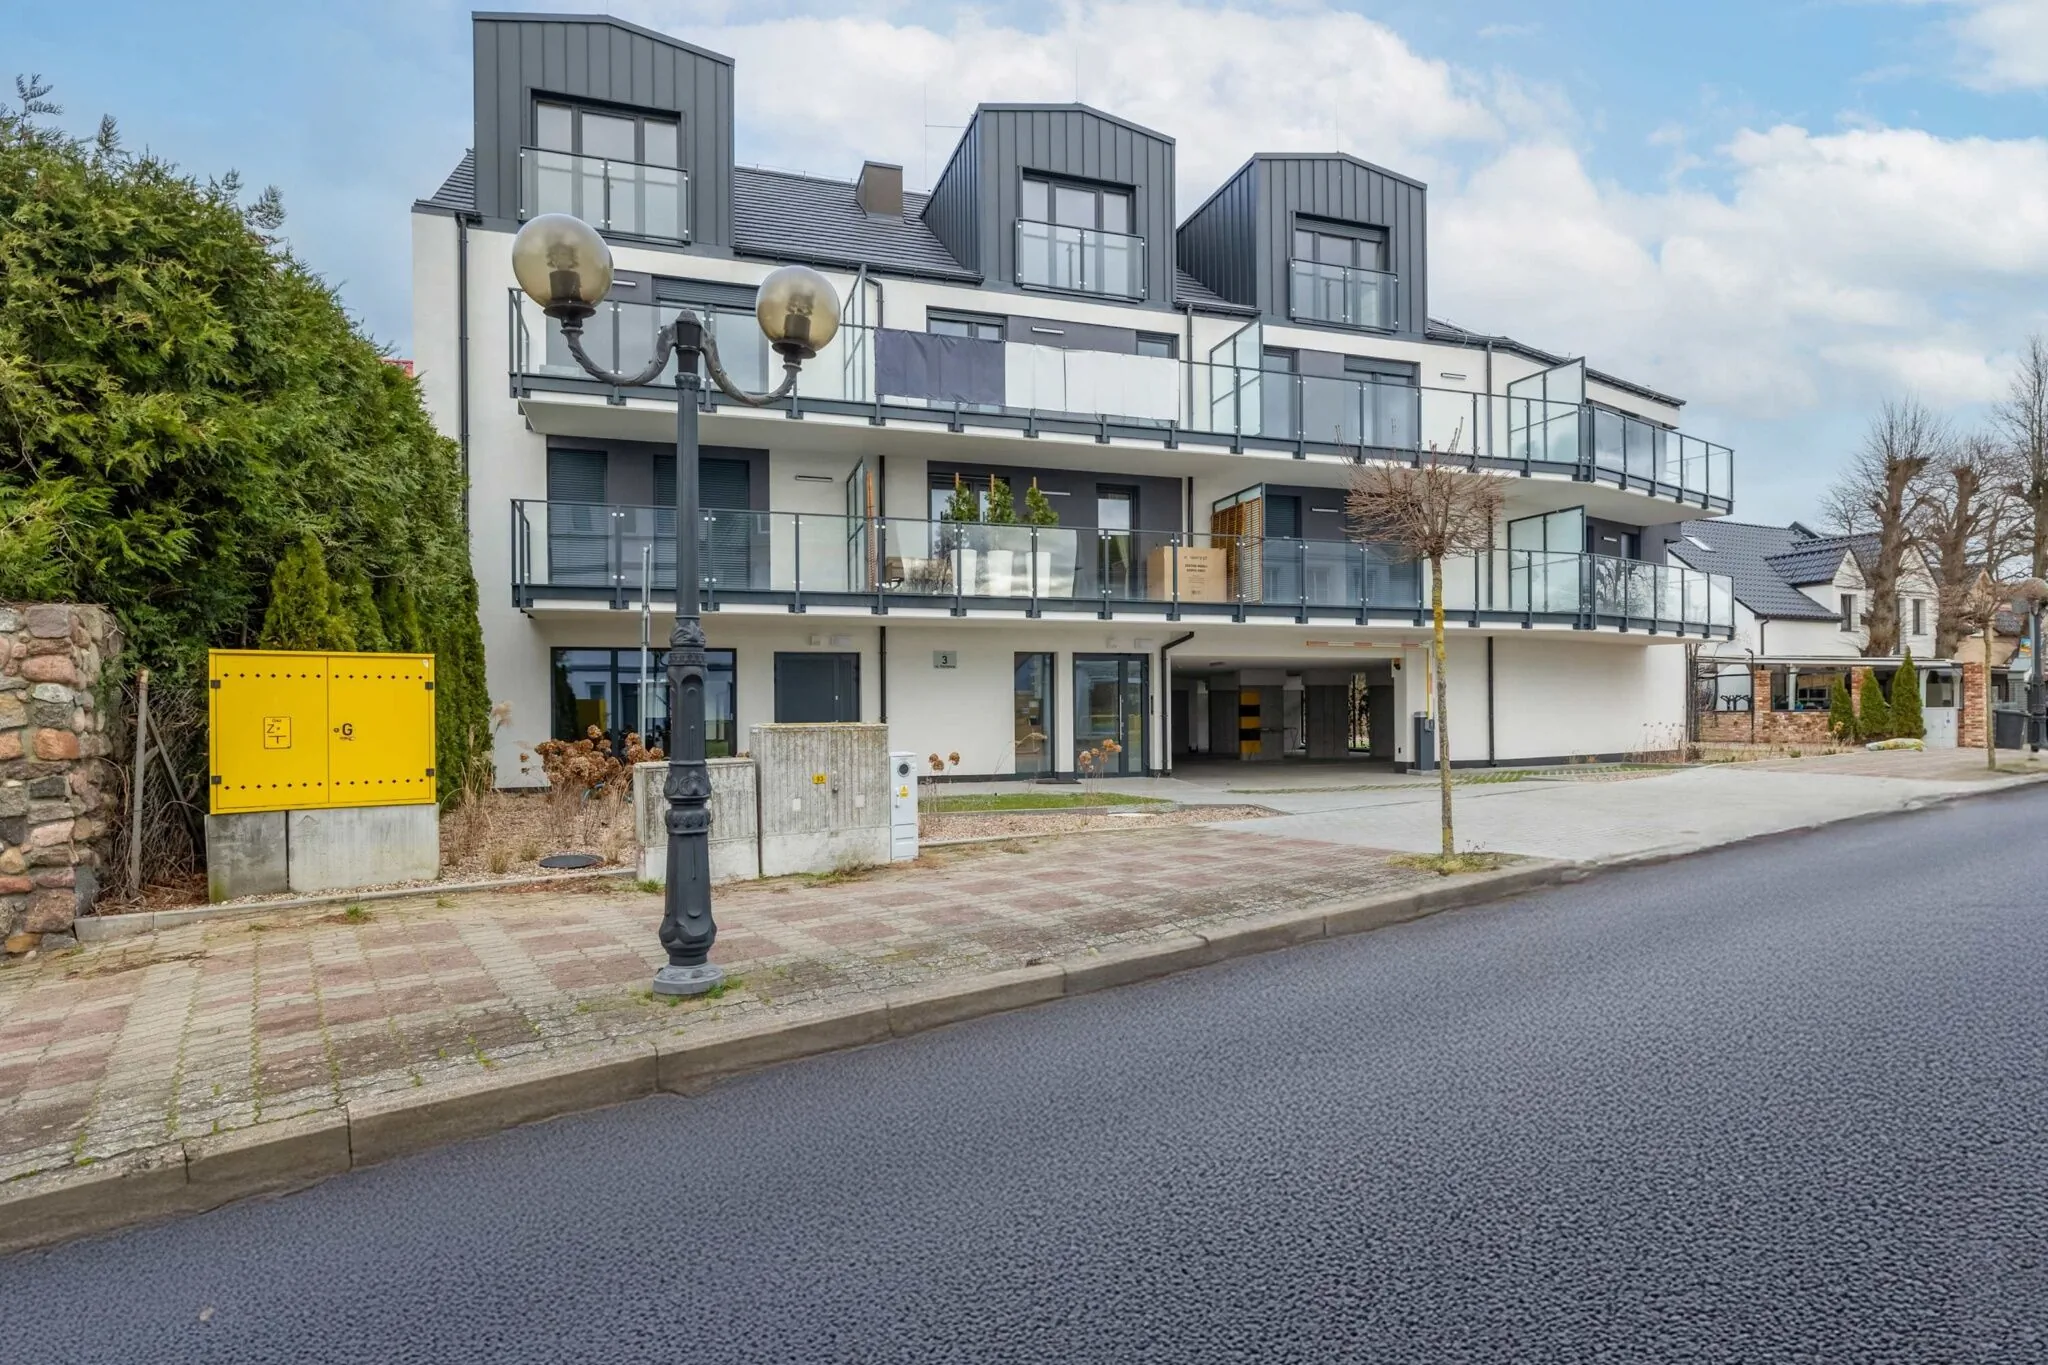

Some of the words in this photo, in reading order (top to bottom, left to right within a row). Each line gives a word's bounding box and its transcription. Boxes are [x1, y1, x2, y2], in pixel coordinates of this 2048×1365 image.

[942, 655, 948, 665] 3
[267, 724, 275, 734] Z
[342, 722, 353, 736] G
